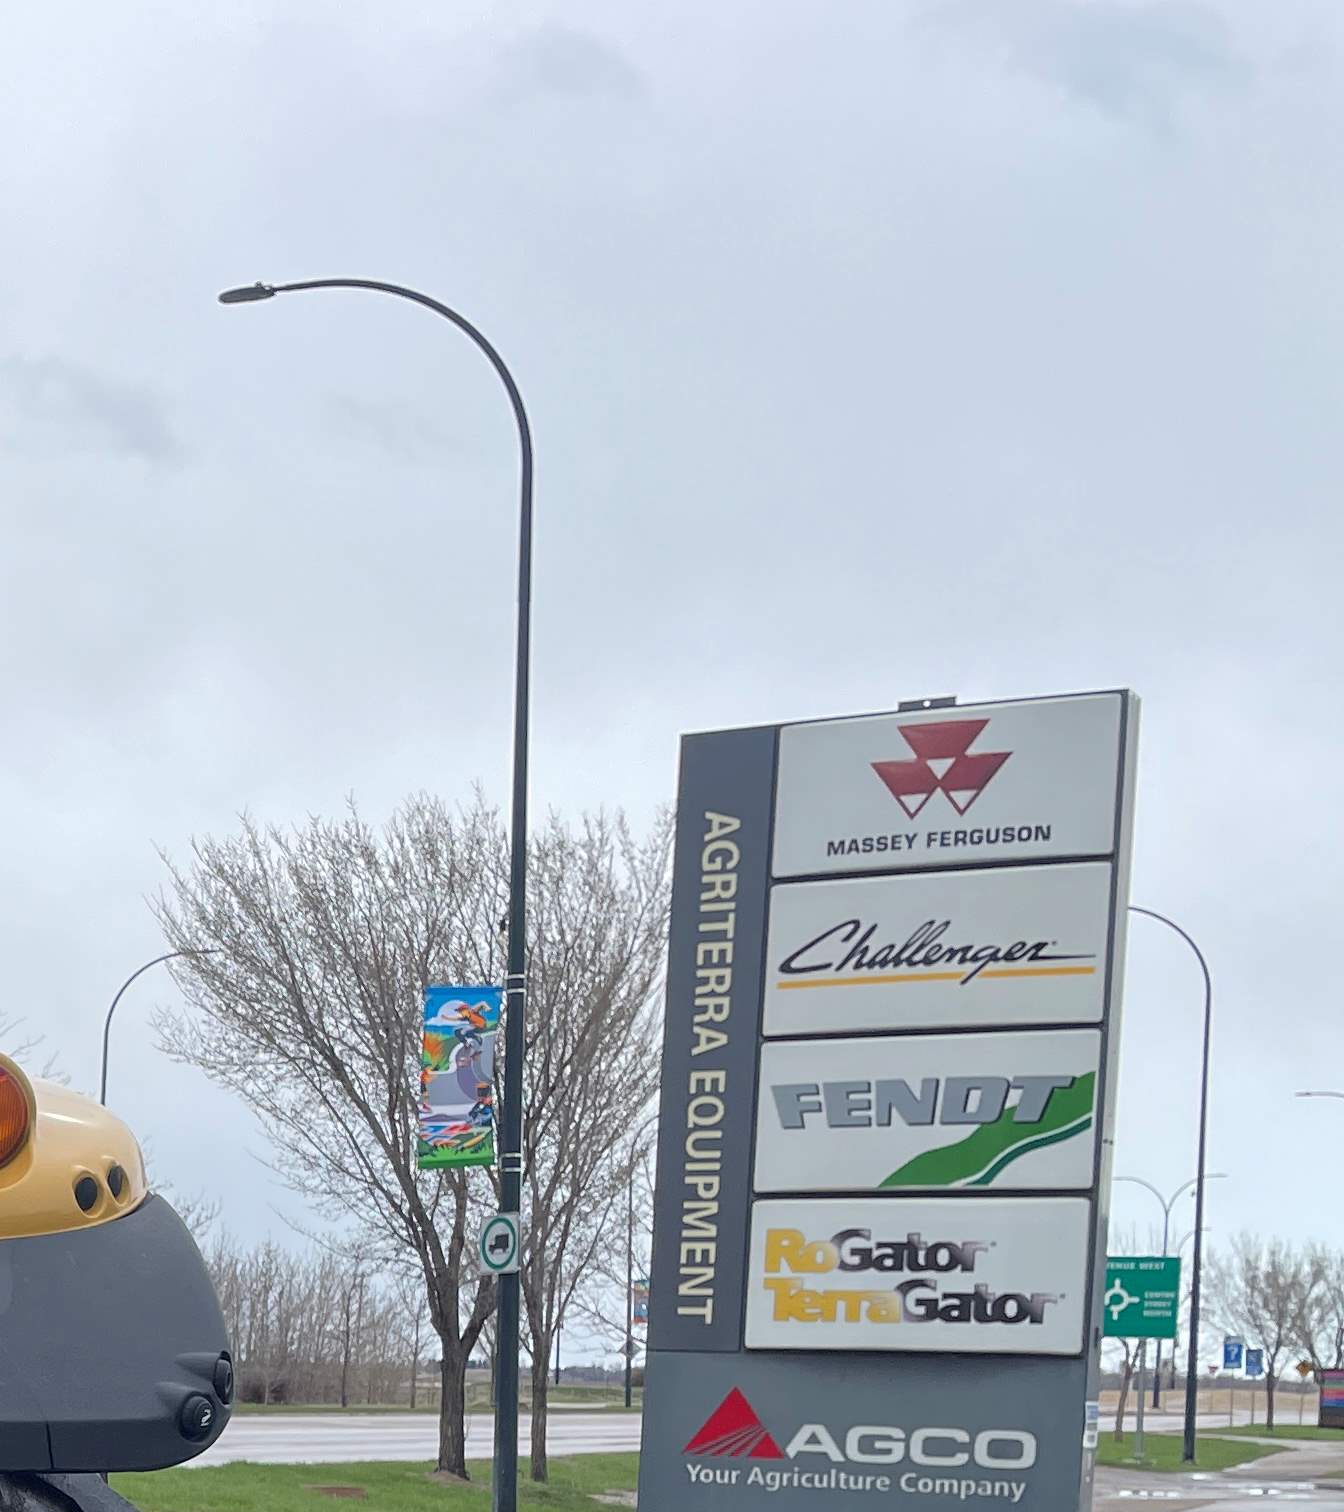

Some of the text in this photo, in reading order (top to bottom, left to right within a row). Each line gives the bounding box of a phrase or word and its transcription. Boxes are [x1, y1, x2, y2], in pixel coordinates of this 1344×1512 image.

[826, 824, 1052, 857] MASSEY FERGUSON
[778, 918, 1096, 985] Challenger
[676, 810, 741, 1324] AGRITERRA EQUIPMENT
[770, 1074, 1078, 1130] FENDT
[764, 1228, 988, 1274] RoGator
[764, 1277, 1059, 1324] TerraGator
[784, 1423, 1037, 1470] AGCO
[686, 1462, 1026, 1502] Your Agriculture Company
